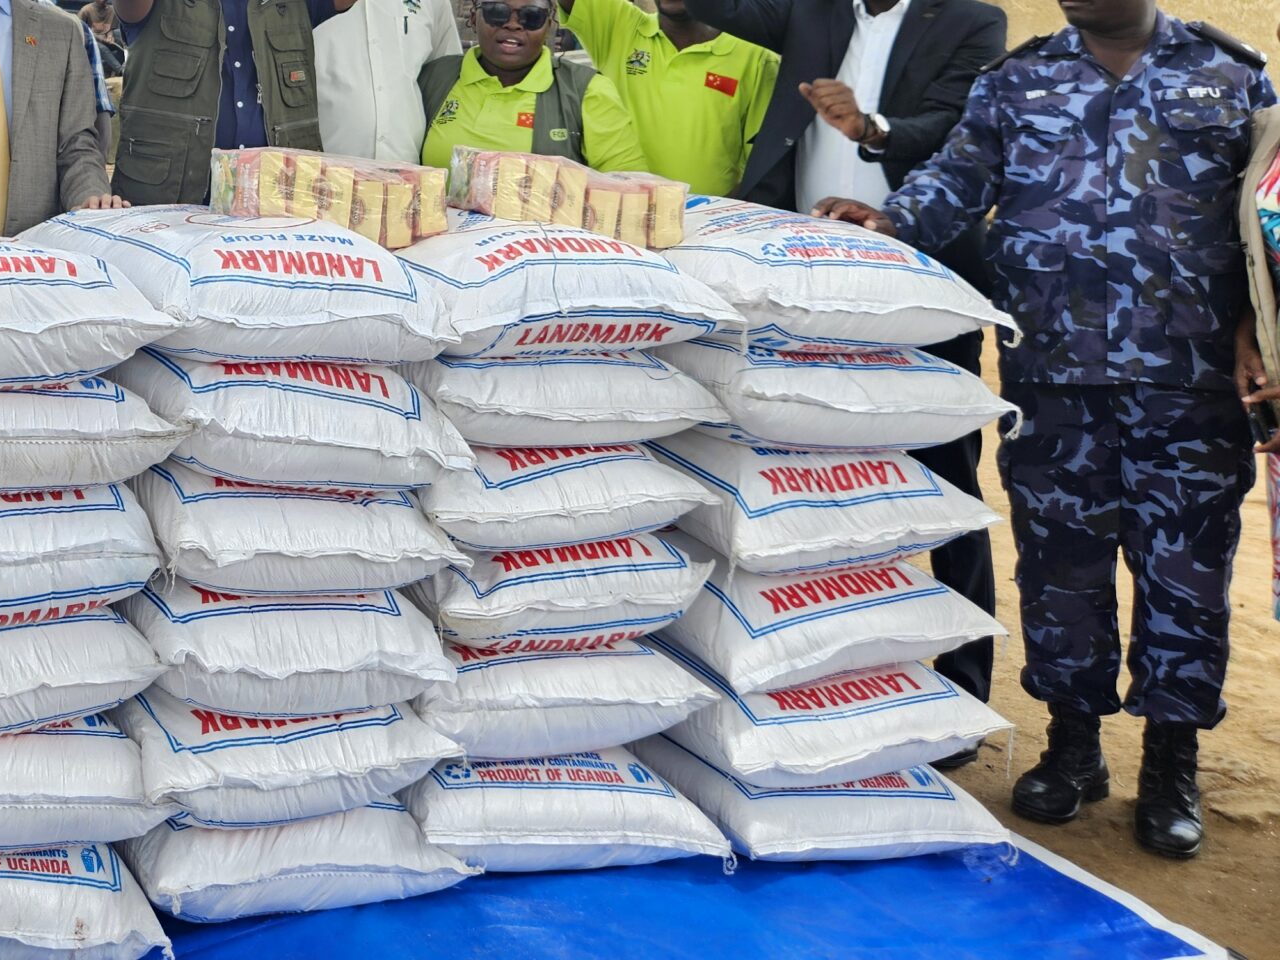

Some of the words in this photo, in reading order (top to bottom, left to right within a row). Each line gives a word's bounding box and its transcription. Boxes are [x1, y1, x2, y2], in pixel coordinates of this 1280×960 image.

[220, 233, 290, 243] FLOUR
[292, 233, 354, 247] MAIZE
[213, 248, 384, 283] LANDMARK
[475, 237, 643, 273] LANDMARK
[857, 248, 910, 264] UGANDA
[514, 322, 674, 347] LANDMARK
[859, 352, 913, 365] UGANDA
[223, 360, 390, 399] LANDMARK
[758, 460, 908, 495] LANDMARK
[492, 537, 653, 573] LANDMARK
[758, 565, 915, 615] LANDMARK
[766, 670, 923, 712] LANDMARK
[477, 767, 542, 783] PRODUCT
[545, 768, 563, 782] OF
[565, 768, 625, 784] UGANDA
[548, 758, 618, 771] CONTAMINANTS
[858, 775, 910, 789] UGANDA
[6, 856, 72, 875] UGANDA
